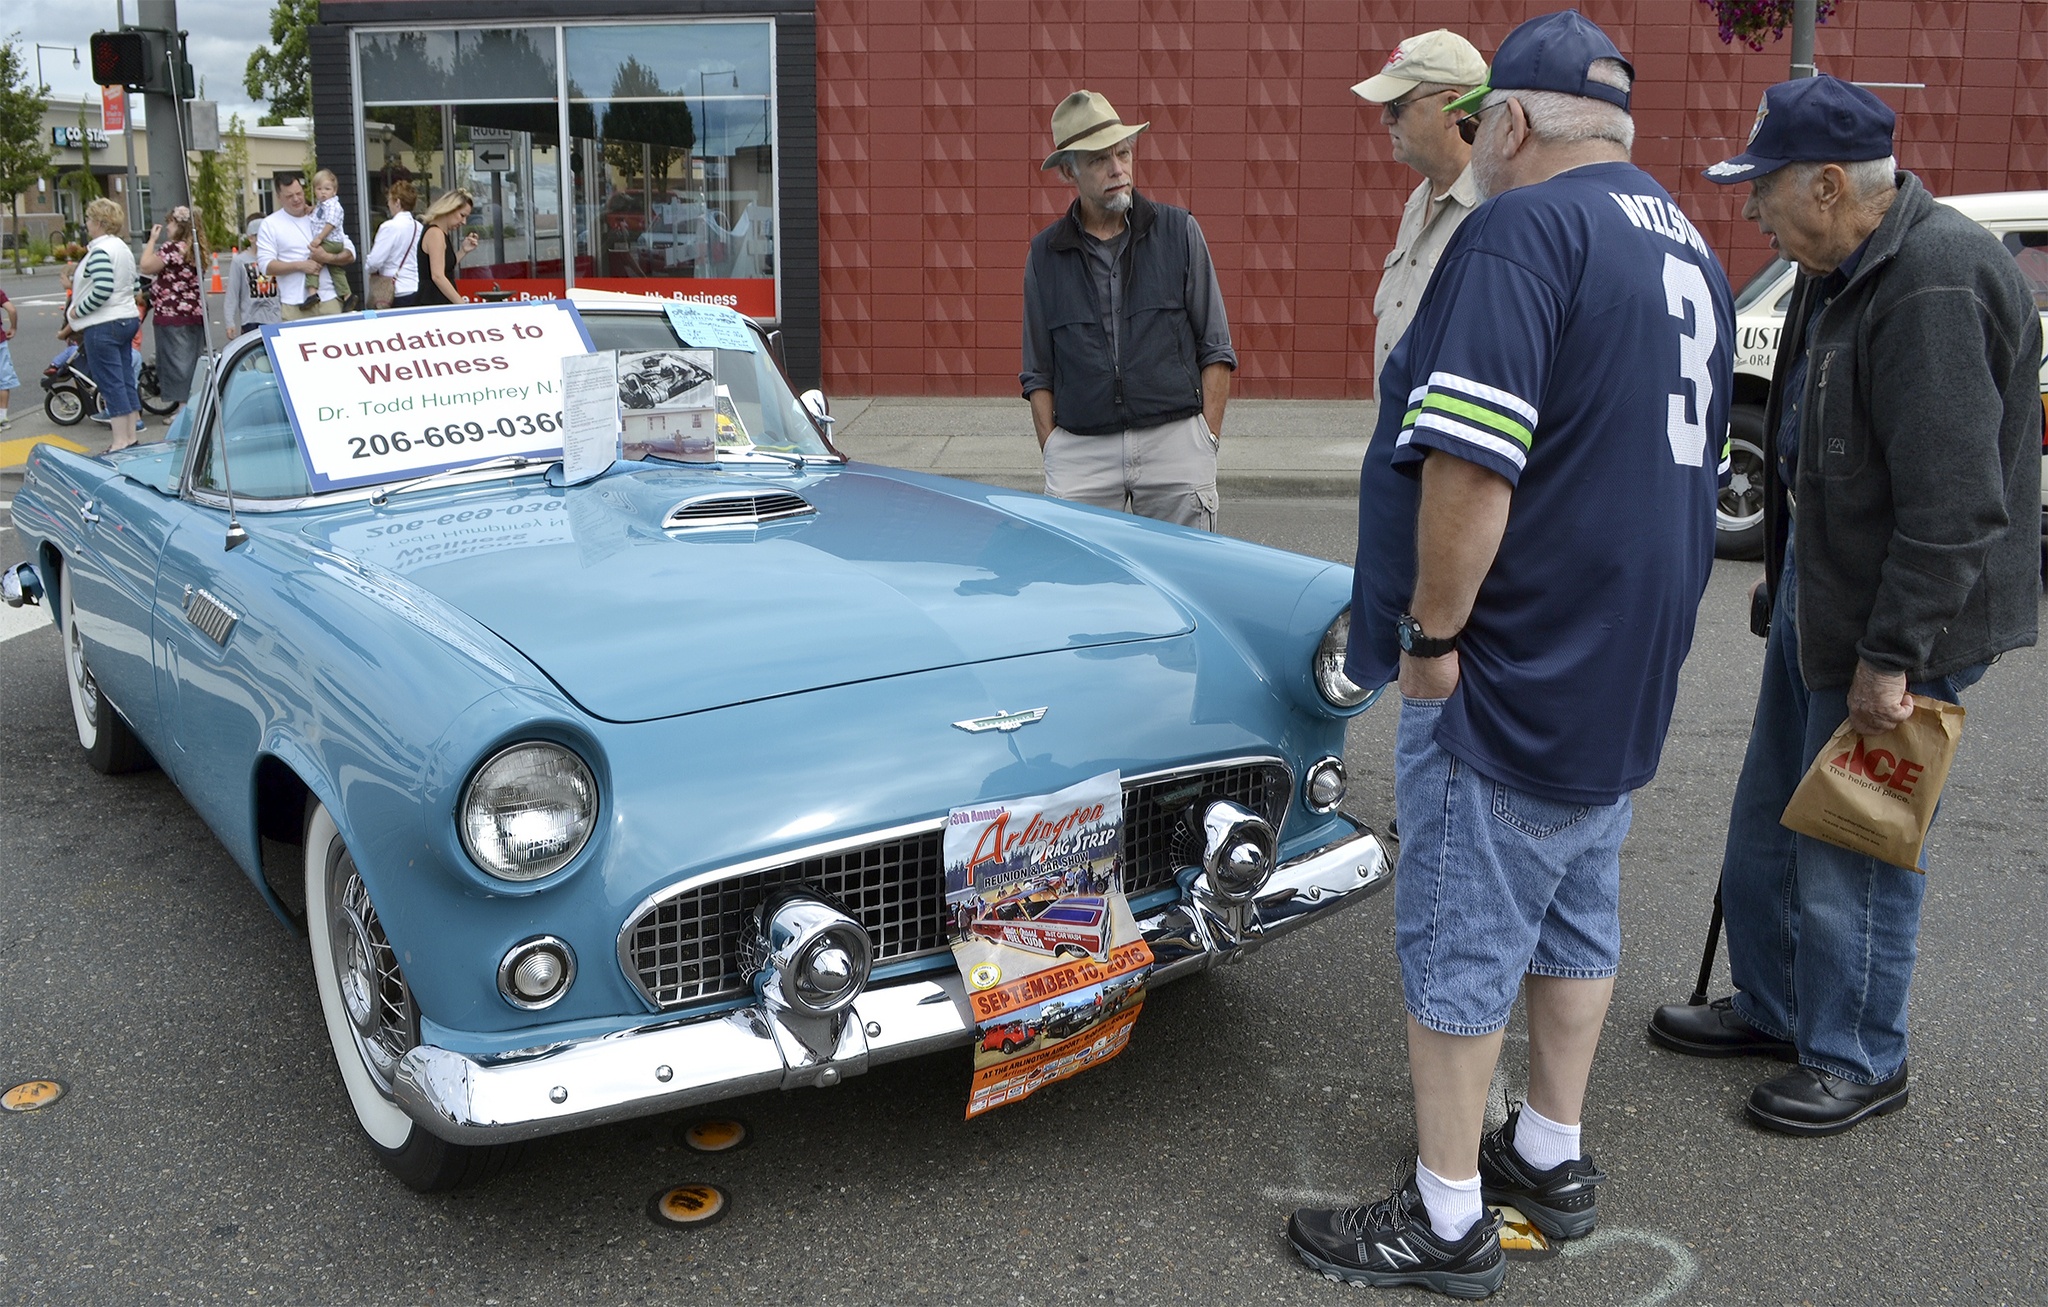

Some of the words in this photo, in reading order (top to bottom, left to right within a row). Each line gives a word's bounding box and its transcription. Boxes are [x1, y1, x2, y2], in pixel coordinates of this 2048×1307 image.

[66, 127, 110, 142] COSTAL
[1609, 192, 1709, 260] WILSON
[673, 291, 738, 306] Business
[299, 324, 504, 362] Foundations
[512, 323, 544, 340] to
[1662, 253, 1717, 467] 3
[1735, 326, 1783, 360] UST
[358, 354, 509, 385] Wellness
[318, 406, 349, 422] Dr.
[358, 396, 414, 417] Todd
[422, 386, 530, 408] Humphrey
[537, 379, 562, 395] N.
[1829, 765, 1846, 778] The
[1847, 774, 1881, 793] helpful
[1882, 788, 1910, 805] place.
[1830, 737, 1925, 795] ACE
[971, 806, 1006, 823] Annual
[965, 802, 1105, 886] Arlington
[1030, 840, 1071, 866] DRAG
[1071, 828, 1116, 854] STRIP
[984, 868, 1028, 888] REUNION
[1030, 866, 1038, 876] &
[1040, 859, 1063, 874] CAR
[1063, 851, 1090, 867] SHOW
[978, 969, 1079, 1015] SEPTEMBER
[1078, 962, 1104, 981] 10,
[1107, 947, 1146, 973] 2016
[982, 1071, 994, 1080] AT
[993, 1065, 1009, 1077] THE
[1009, 1052, 1051, 1074] ARLINGTON
[1050, 1040, 1079, 1057] AIRPORT
